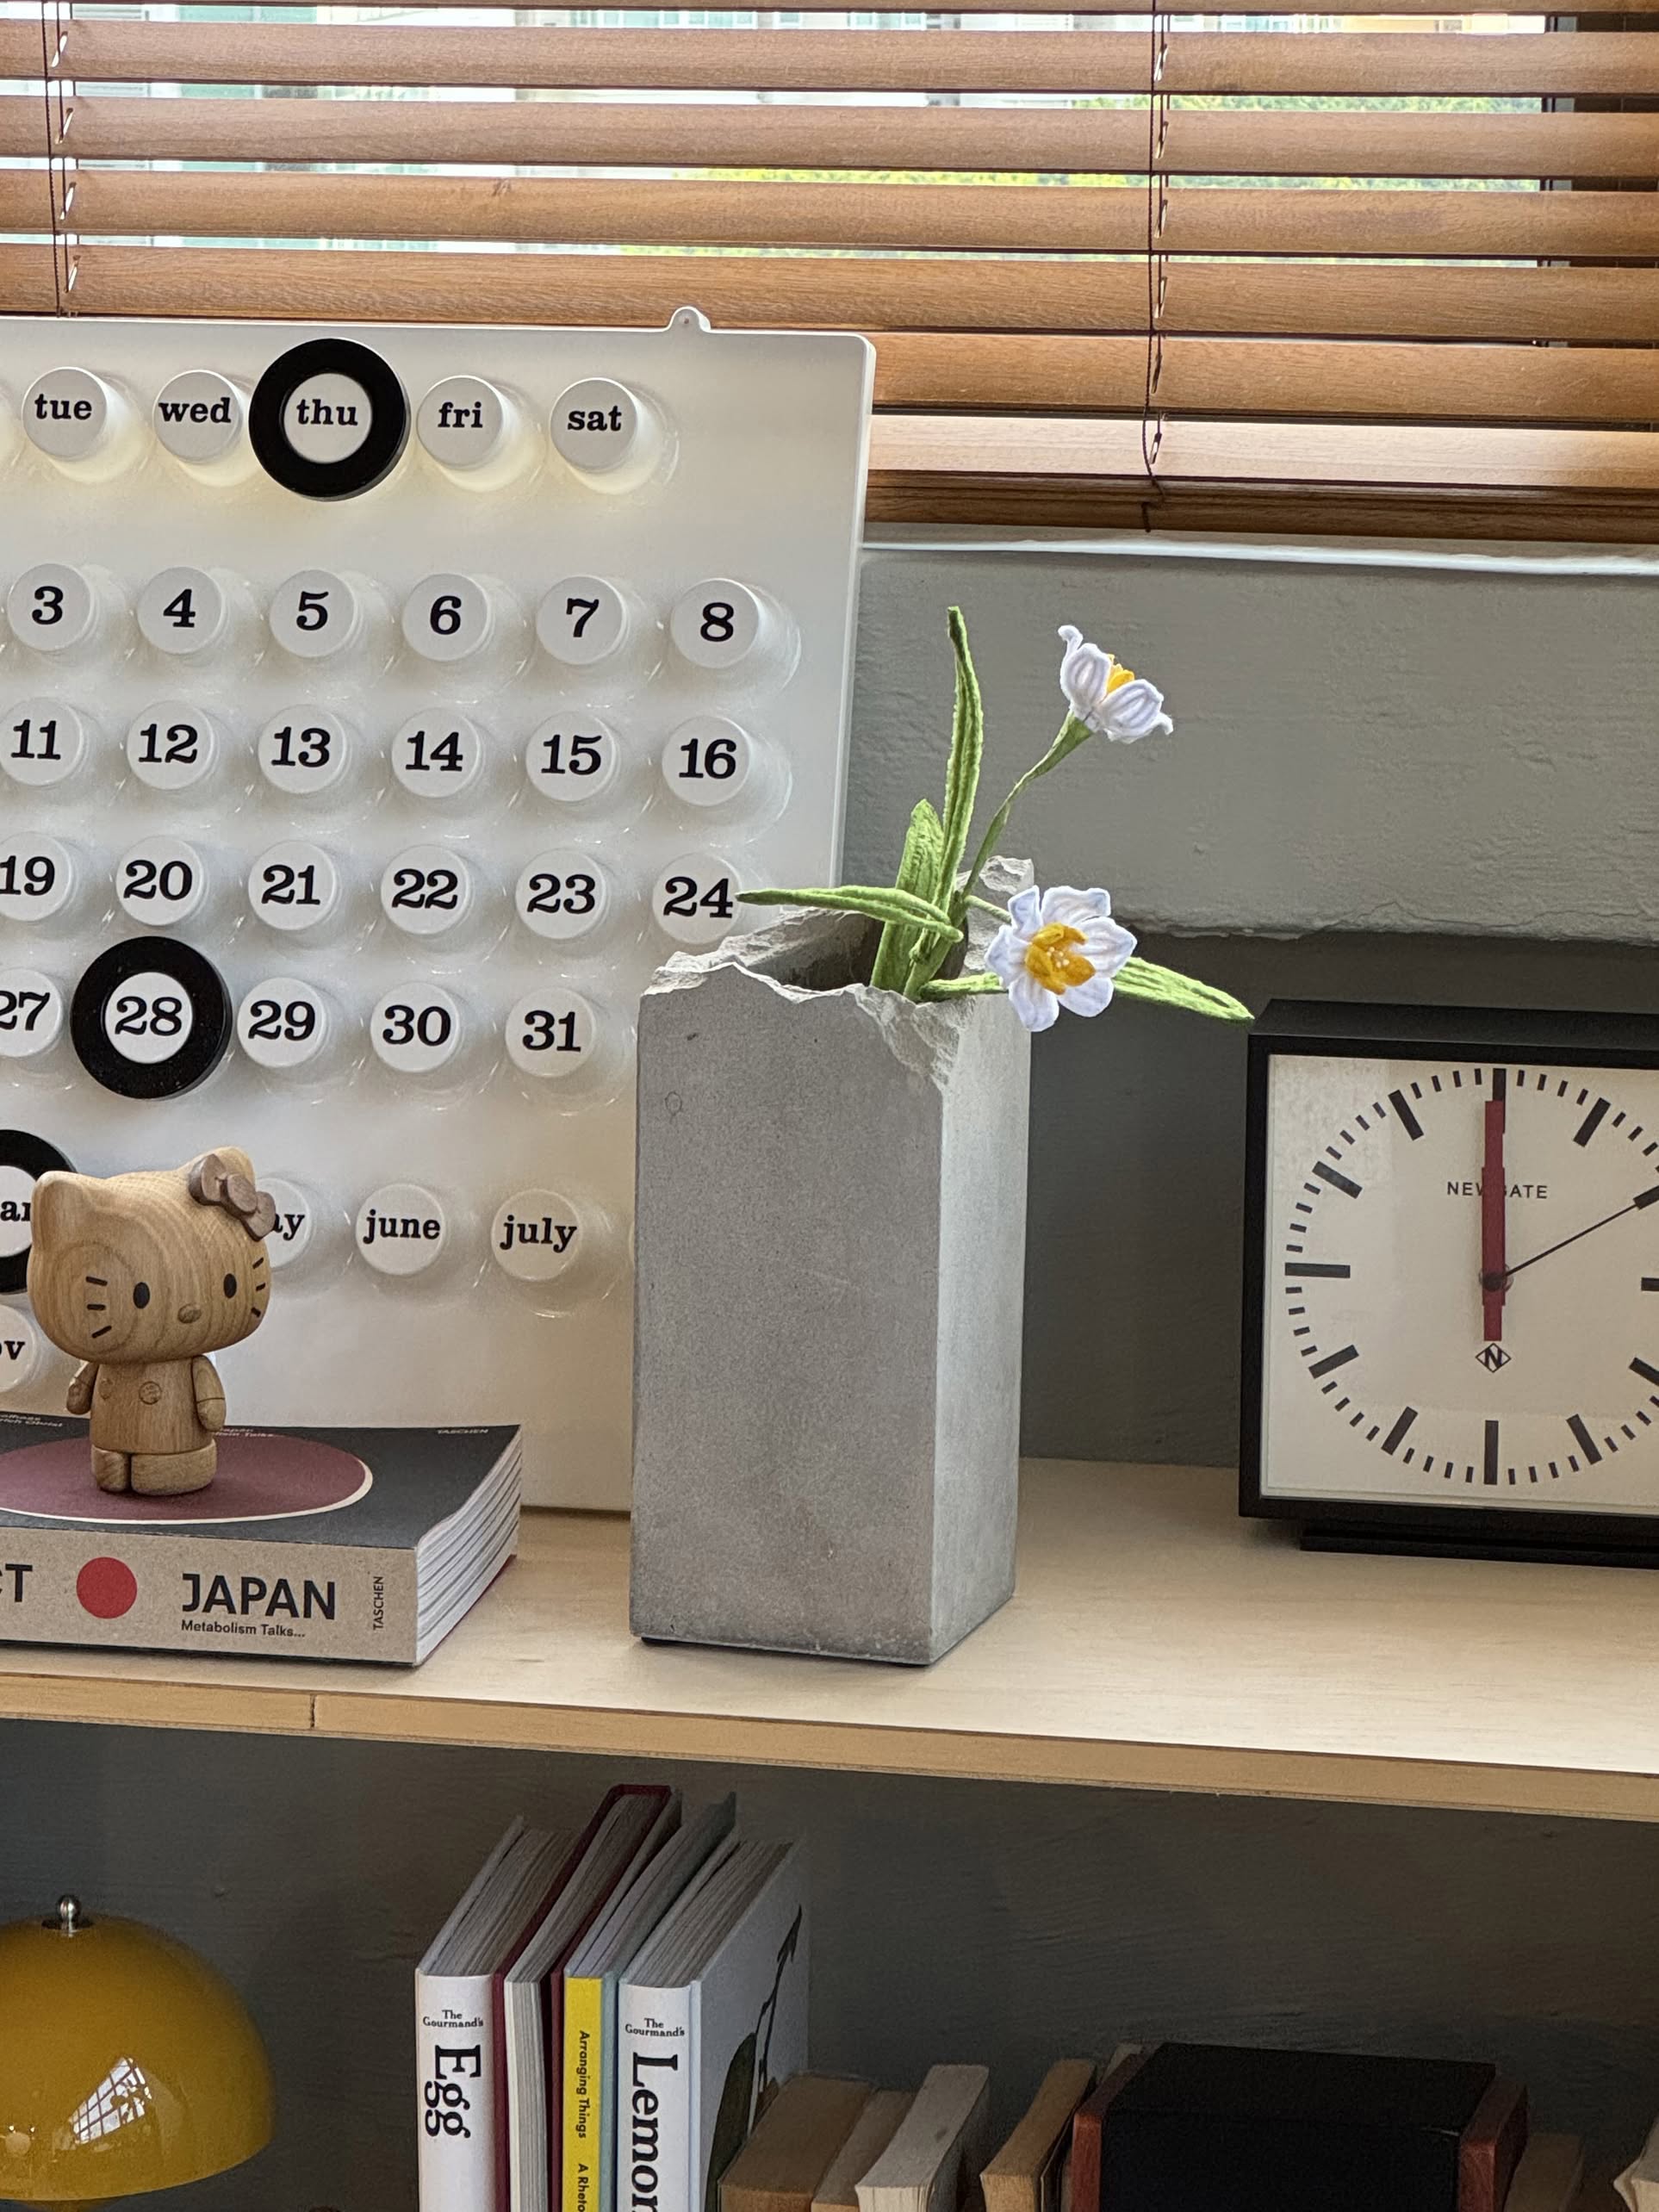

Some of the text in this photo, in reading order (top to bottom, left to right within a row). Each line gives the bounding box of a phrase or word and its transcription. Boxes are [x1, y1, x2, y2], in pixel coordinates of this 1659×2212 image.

[34, 394, 622, 432] tue wed thu fri sat
[32, 586, 735, 642] 3 4 5 6 7 8
[10, 719, 737, 780] 11 12 13 14 15 16
[0, 855, 734, 919] 19 20 21 22 23 24
[115, 996, 183, 1036] 28
[247, 1000, 315, 1041] 29
[382, 1004, 451, 1046] 30
[522, 1010, 581, 1053] 31
[1447, 1181, 1548, 1199] NEATE
[363, 1209, 441, 1245] june
[500, 1215, 577, 1253] july
[182, 1572, 336, 1620] JAPAN
[372, 1575, 384, 1631] TASCHEN
[181, 1619, 257, 1634] Metabolism
[423, 2016, 484, 2028] Gourmand's
[442, 2010, 463, 2021] The
[624, 2023, 686, 2037] Gourmand's
[644, 2017, 664, 2029] The
[575, 2029, 591, 2096] Arranging
[424, 2044, 482, 2139] Egg
[575, 2097, 591, 2140] Things
[578, 2163, 589, 2174] A
